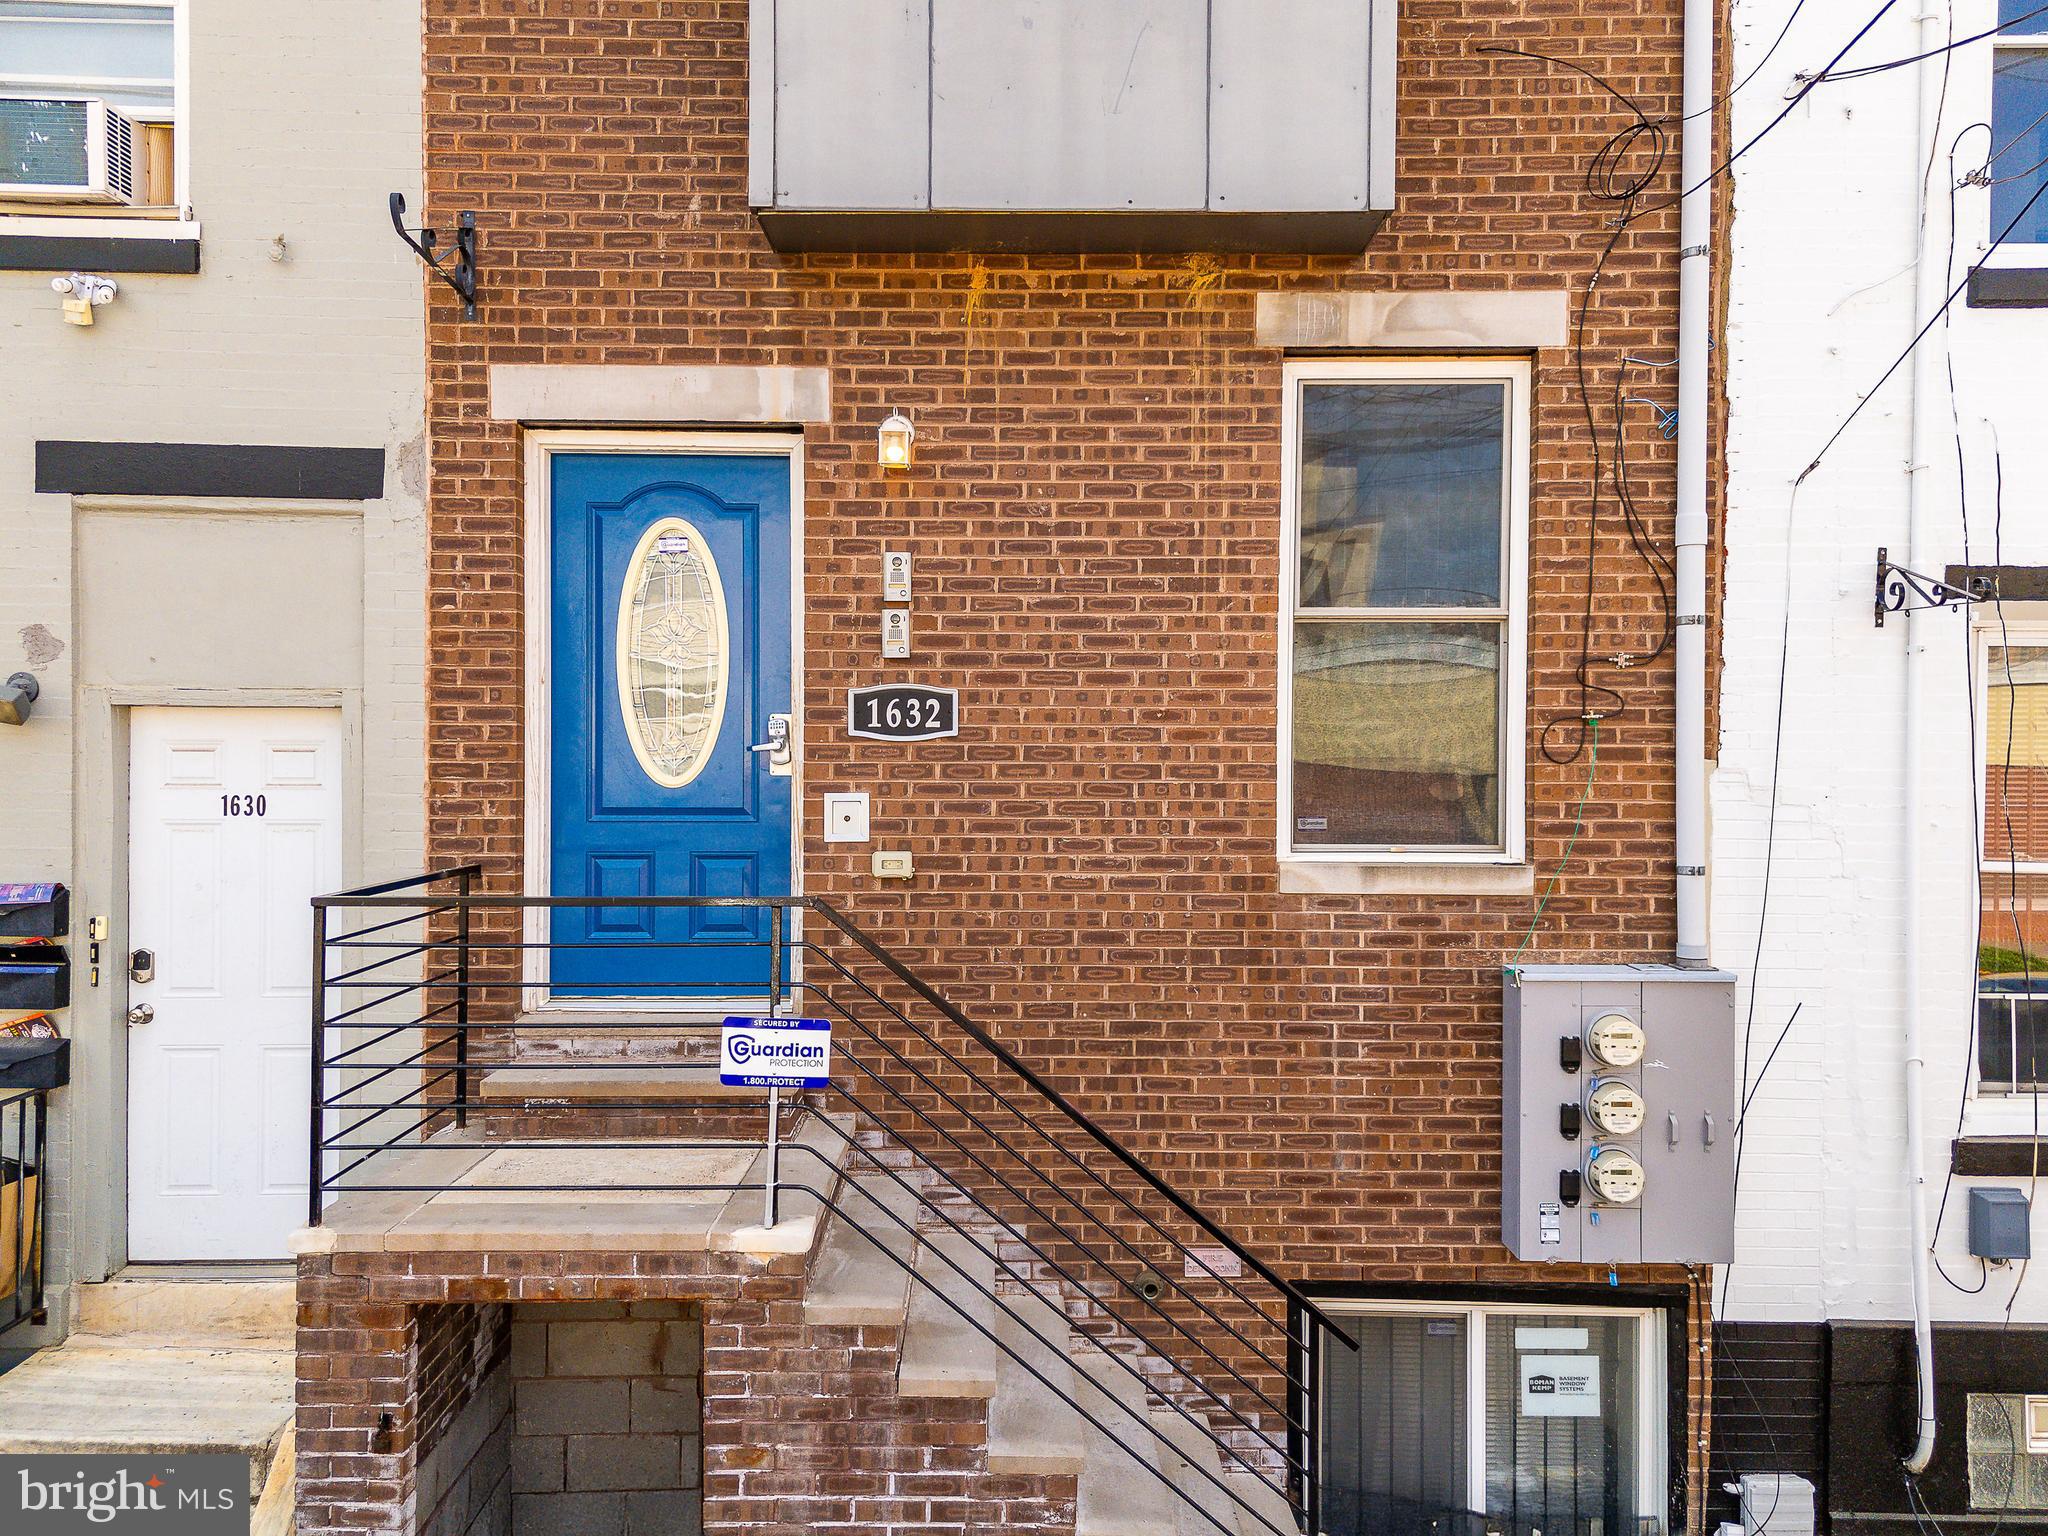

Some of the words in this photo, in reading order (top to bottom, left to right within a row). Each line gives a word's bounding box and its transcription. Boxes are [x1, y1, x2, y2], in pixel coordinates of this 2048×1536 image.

[866, 698, 942, 728] 1632
[220, 794, 267, 817] 1630
[753, 1019, 788, 1028] SECURED
[789, 1020, 800, 1028] BY
[730, 1038, 824, 1059] Guardian
[769, 1058, 824, 1068] PROTECTION
[742, 1076, 805, 1087] 1.800.PROTECT
